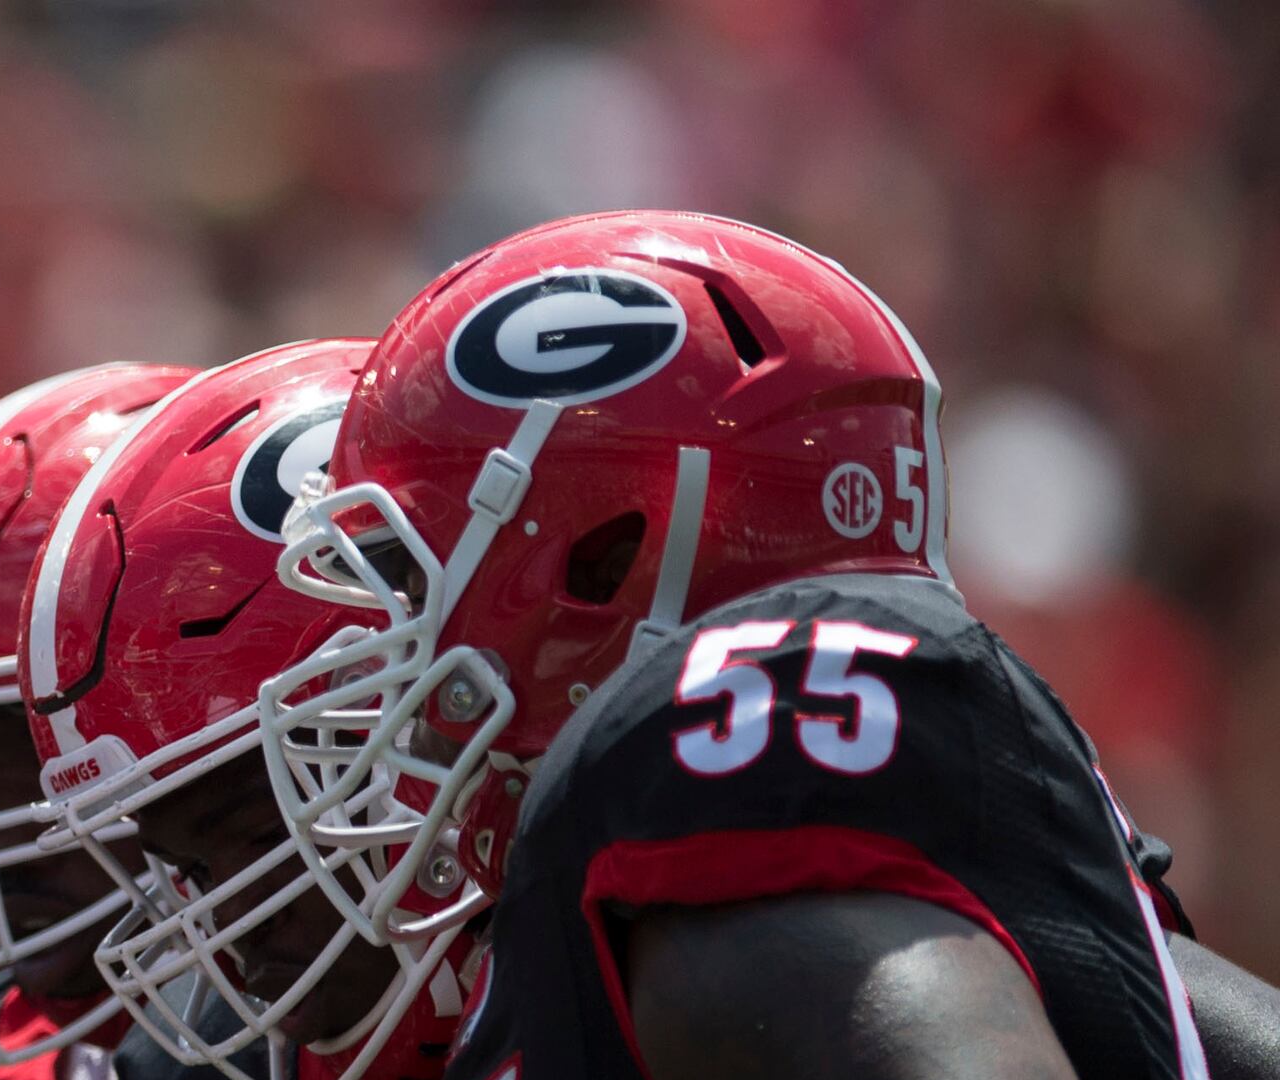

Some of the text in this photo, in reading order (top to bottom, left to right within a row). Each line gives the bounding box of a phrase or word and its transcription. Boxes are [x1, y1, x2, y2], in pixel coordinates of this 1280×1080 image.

[450, 271, 682, 405] G
[830, 470, 877, 529] SEC
[672, 618, 920, 779] 55
